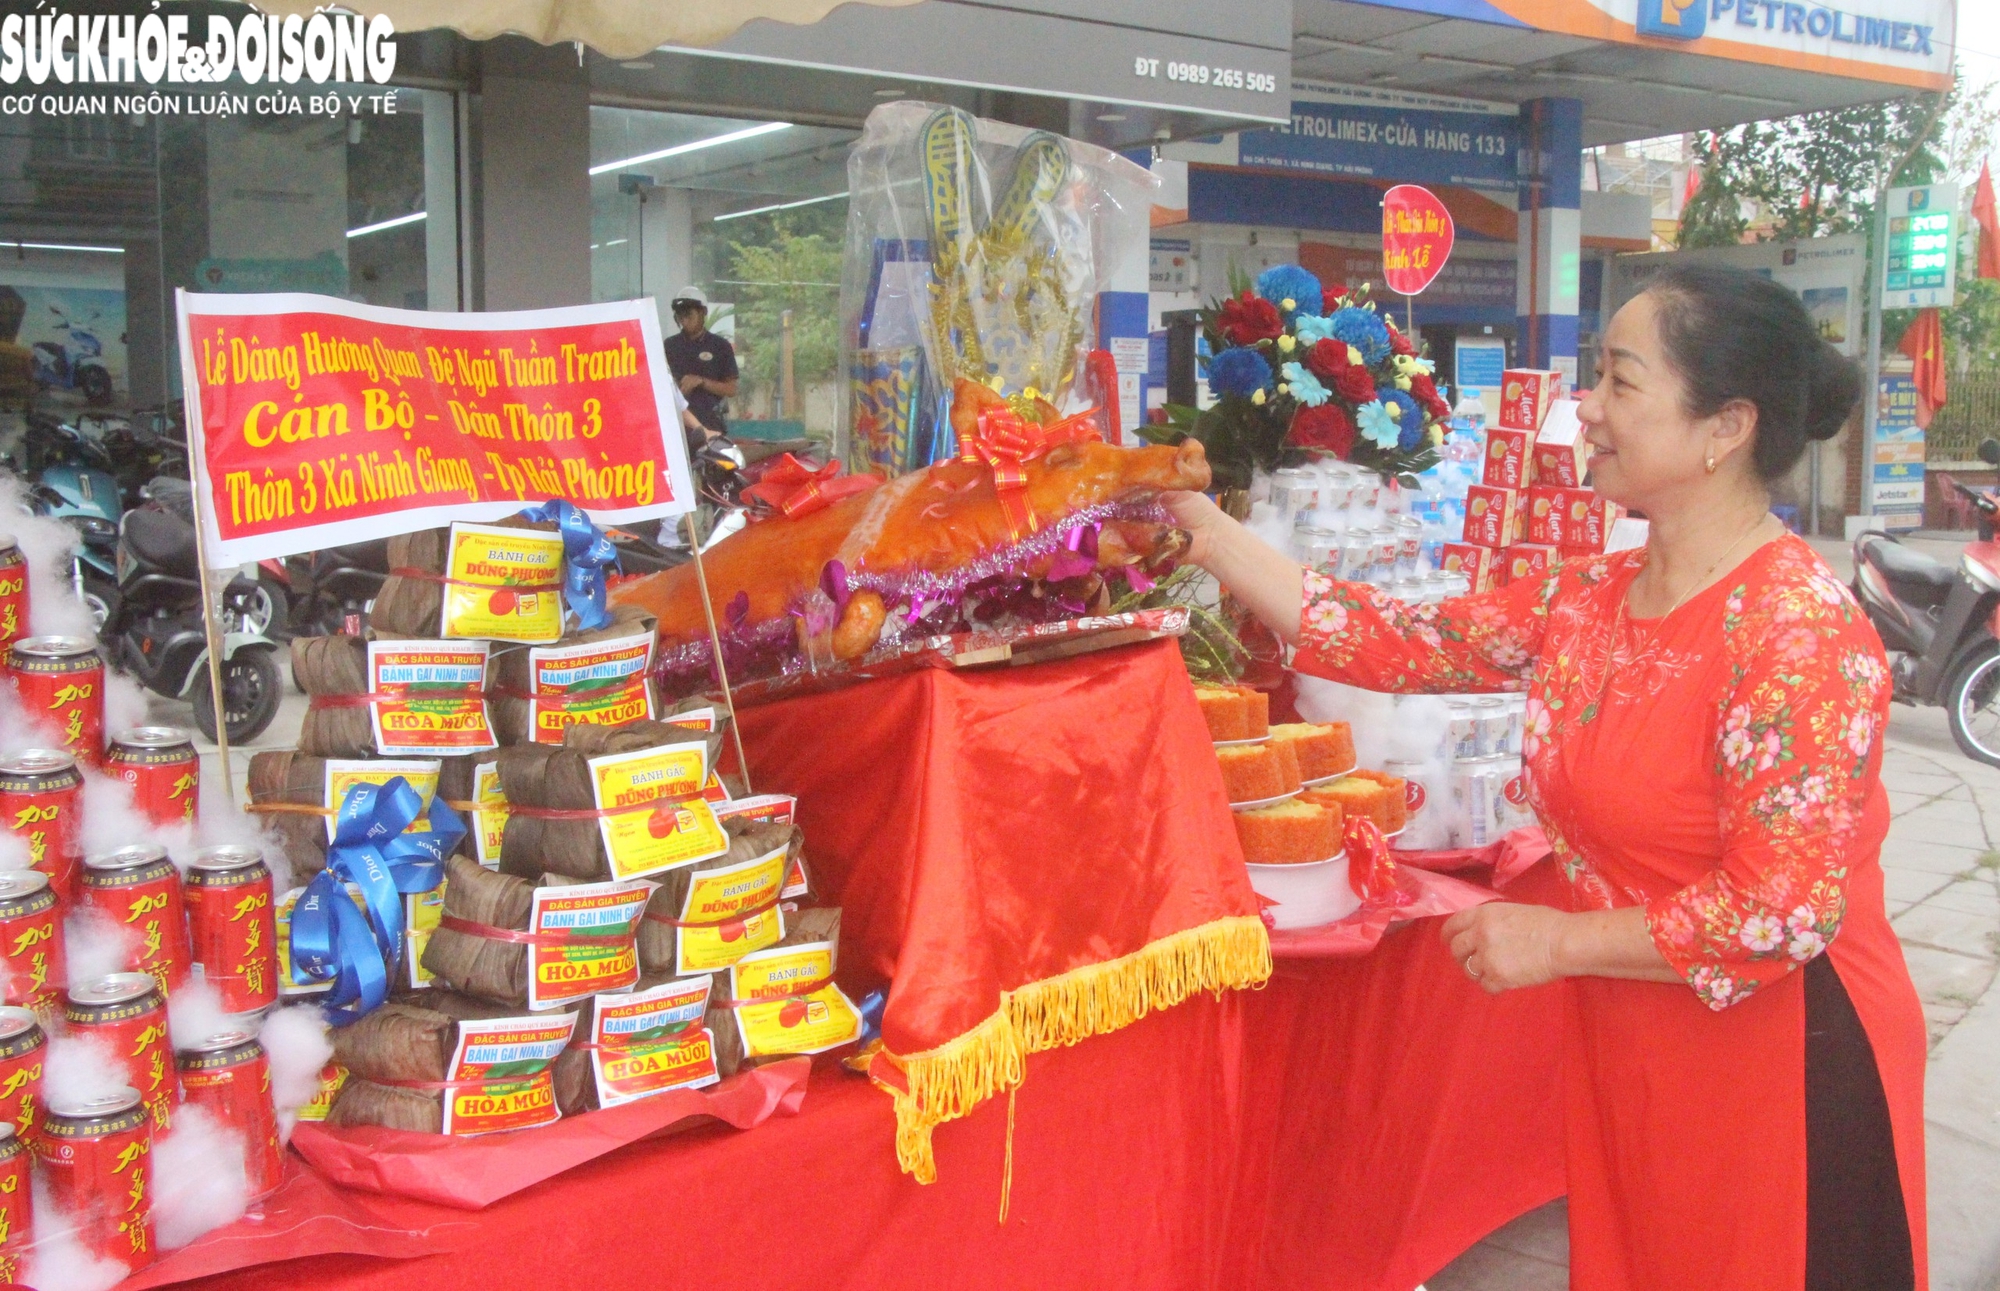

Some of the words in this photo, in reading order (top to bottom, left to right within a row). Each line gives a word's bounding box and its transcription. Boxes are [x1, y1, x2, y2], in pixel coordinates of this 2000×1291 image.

[1709, 0, 1934, 56] PETROLIMEX
[1135, 57, 1159, 78] ĐT
[1167, 60, 1209, 84] 0989
[1213, 66, 1243, 89] 265
[1246, 70, 1276, 93] 505
[1270, 115, 1418, 147] TROLIMEX-CỬA
[1424, 123, 1470, 152] HÀNG
[1476, 135, 1506, 156] 133
[1412, 244, 1432, 270] Lễ
[203, 328, 227, 386] Lễ
[230, 335, 302, 390] Dâng
[301, 331, 379, 383] Hương
[373, 337, 424, 386] Quan
[426, 346, 458, 397] Đệ
[454, 348, 499, 397] Ngũ
[499, 338, 558, 387] Tuần
[561, 337, 637, 384] Tranh
[244, 393, 350, 448] Cán
[362, 388, 415, 441] Bộ
[447, 400, 504, 440] Dân
[503, 402, 574, 442] Thôn
[582, 398, 602, 439] 3
[1521, 393, 1534, 425] Marie
[1505, 452, 1518, 484] Marie
[225, 467, 295, 527] Thôn
[299, 461, 317, 514] 3
[318, 453, 358, 510] Xã
[356, 449, 417, 503] Ninh
[415, 446, 478, 502] Giang
[518, 456, 566, 497] Hải
[561, 452, 655, 505] Phòng
[1876, 489, 1908, 500] Jetstar
[1485, 509, 1499, 543] Marie
[488, 549, 524, 562] BÁNH
[592, 538, 611, 563] Dior
[385, 655, 408, 665] ĐẶC
[411, 654, 431, 663] SẢN
[541, 671, 571, 684] BÁNH
[574, 669, 590, 681] GAI
[592, 664, 617, 677] NINH
[620, 658, 644, 675] GIANG
[545, 661, 567, 670] ĐẶC
[570, 658, 589, 668] SẢN
[592, 655, 608, 664] GIA
[382, 666, 413, 682] BÁNH
[416, 668, 432, 681] GAI
[435, 668, 458, 681] NINH
[390, 712, 434, 728] HÒA
[440, 713, 484, 729] MƯỜI
[596, 701, 642, 724] MƯỜI
[632, 769, 664, 785] BÁNH
[349, 789, 370, 819] Dior
[362, 854, 384, 882] Dior
[549, 901, 572, 911] ĐẶC
[574, 898, 595, 909] SẢN
[597, 898, 614, 906] GIA
[543, 911, 575, 927] BÁNH
[578, 911, 596, 926] GAI
[600, 908, 623, 923] NINH
[546, 960, 591, 981] HÒA
[768, 968, 798, 982] BÁNH
[606, 1018, 637, 1032] BÁNH
[640, 1017, 656, 1030] GAI
[657, 1010, 681, 1025] NINH
[611, 1007, 632, 1018] ĐẶC
[636, 1003, 654, 1014] SẢN
[657, 1001, 672, 1009] GIA
[474, 1034, 496, 1044] ĐẶC
[498, 1031, 518, 1043] SẢN
[520, 1033, 536, 1041] GIA
[467, 1046, 498, 1062] BÁNH
[500, 1047, 518, 1061] GAI
[519, 1045, 544, 1059] NINH
[612, 1055, 660, 1078] HÒA
[665, 1043, 707, 1067] MƯỜI
[463, 1095, 508, 1115] HÒA
[514, 1084, 551, 1110] MƯỜ
